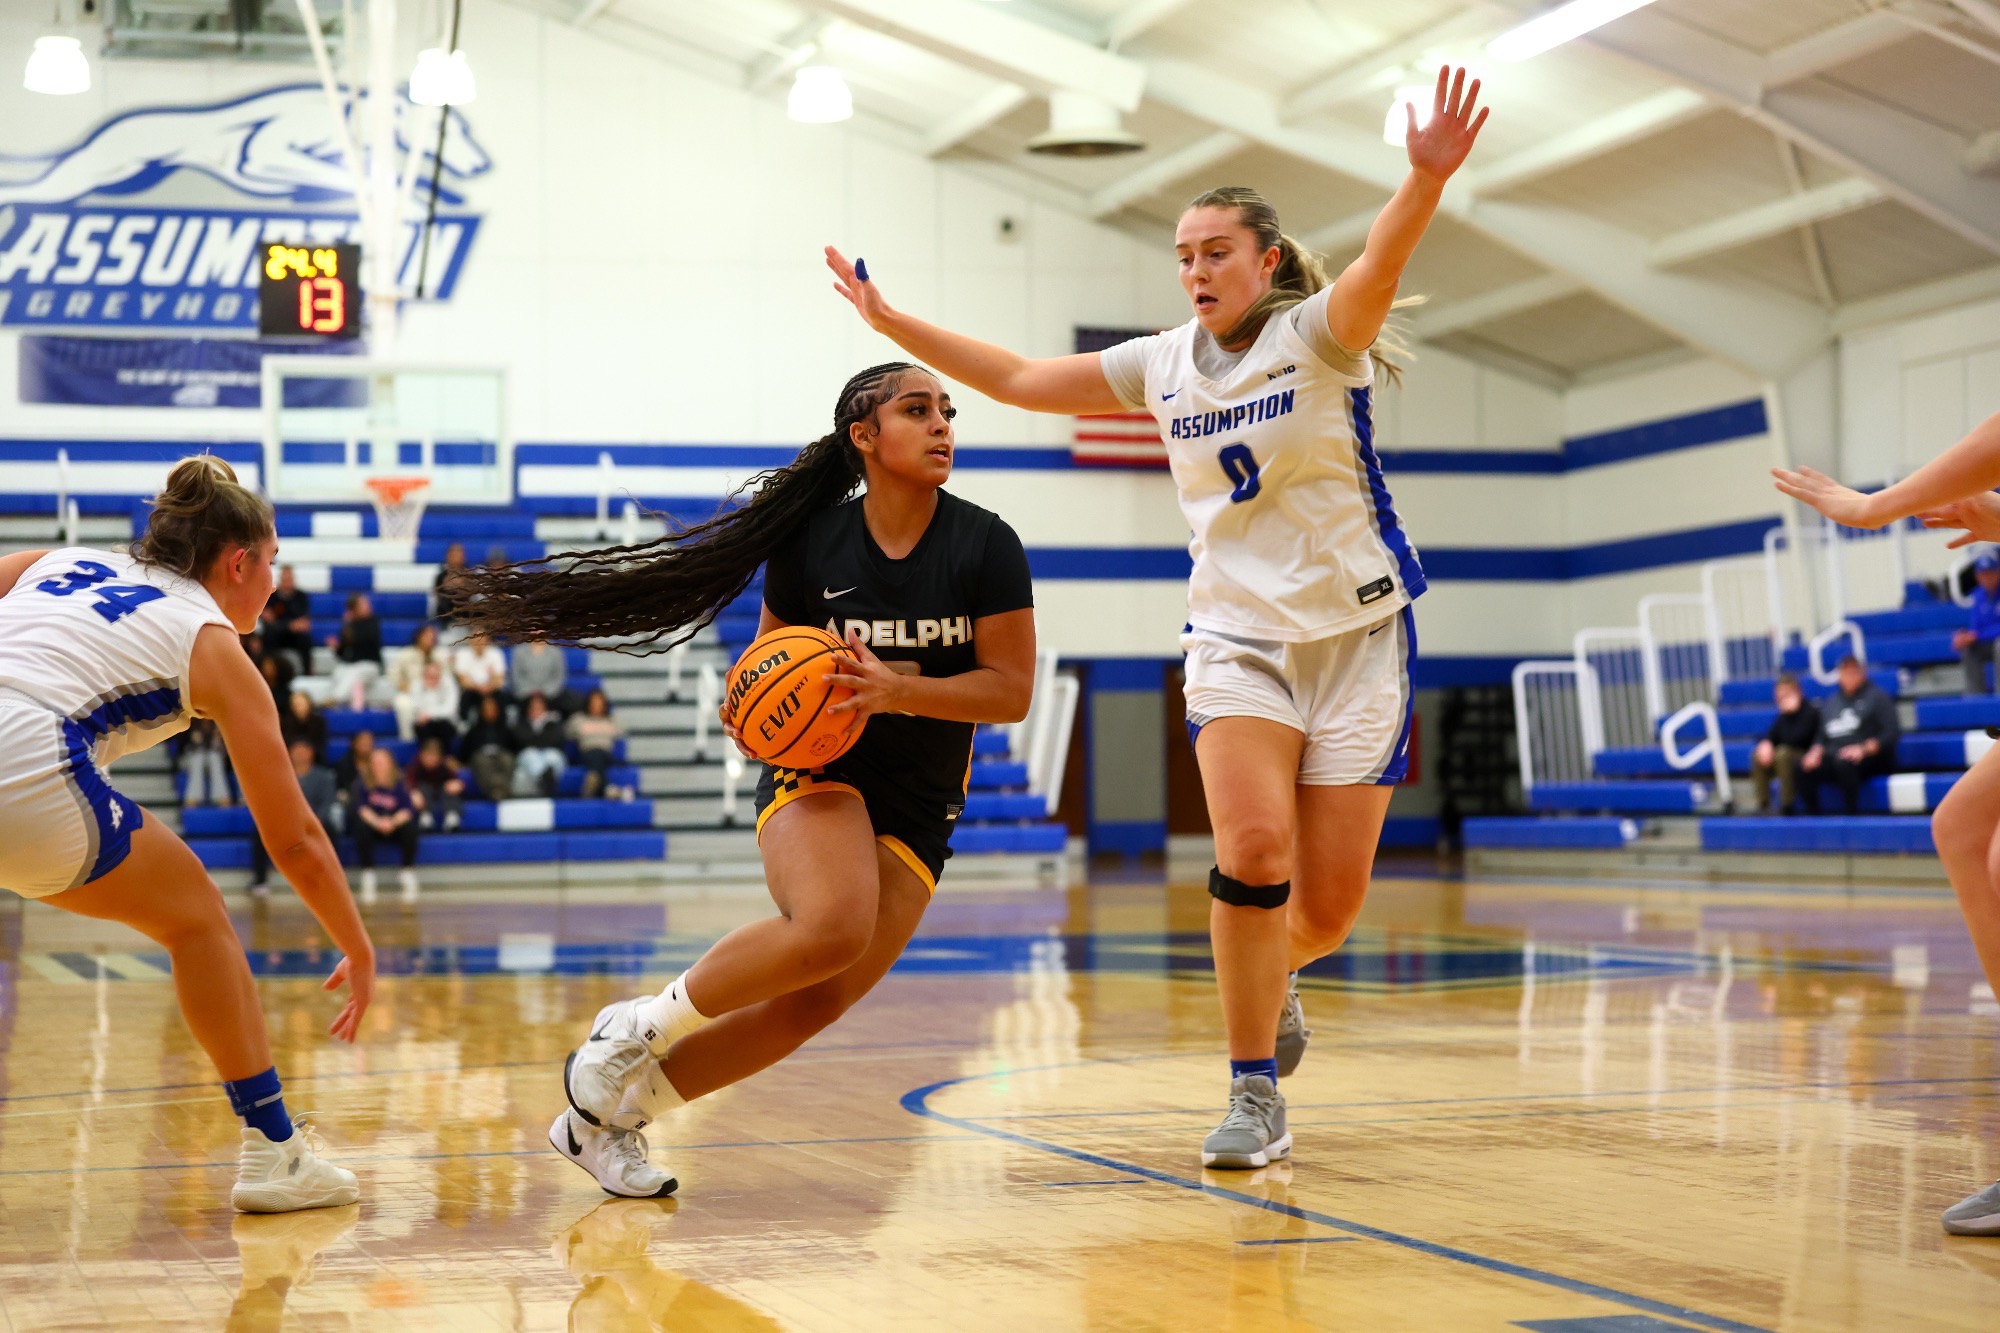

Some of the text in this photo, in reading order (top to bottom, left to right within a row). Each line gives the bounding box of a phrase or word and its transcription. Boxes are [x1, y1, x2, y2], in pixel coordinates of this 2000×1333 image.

[25, 288, 261, 322] GREYHO
[299, 277, 344, 332] 13
[1171, 388, 1295, 439] ASSUMPTION
[1217, 441, 1262, 504] 0
[36, 560, 167, 624] 34
